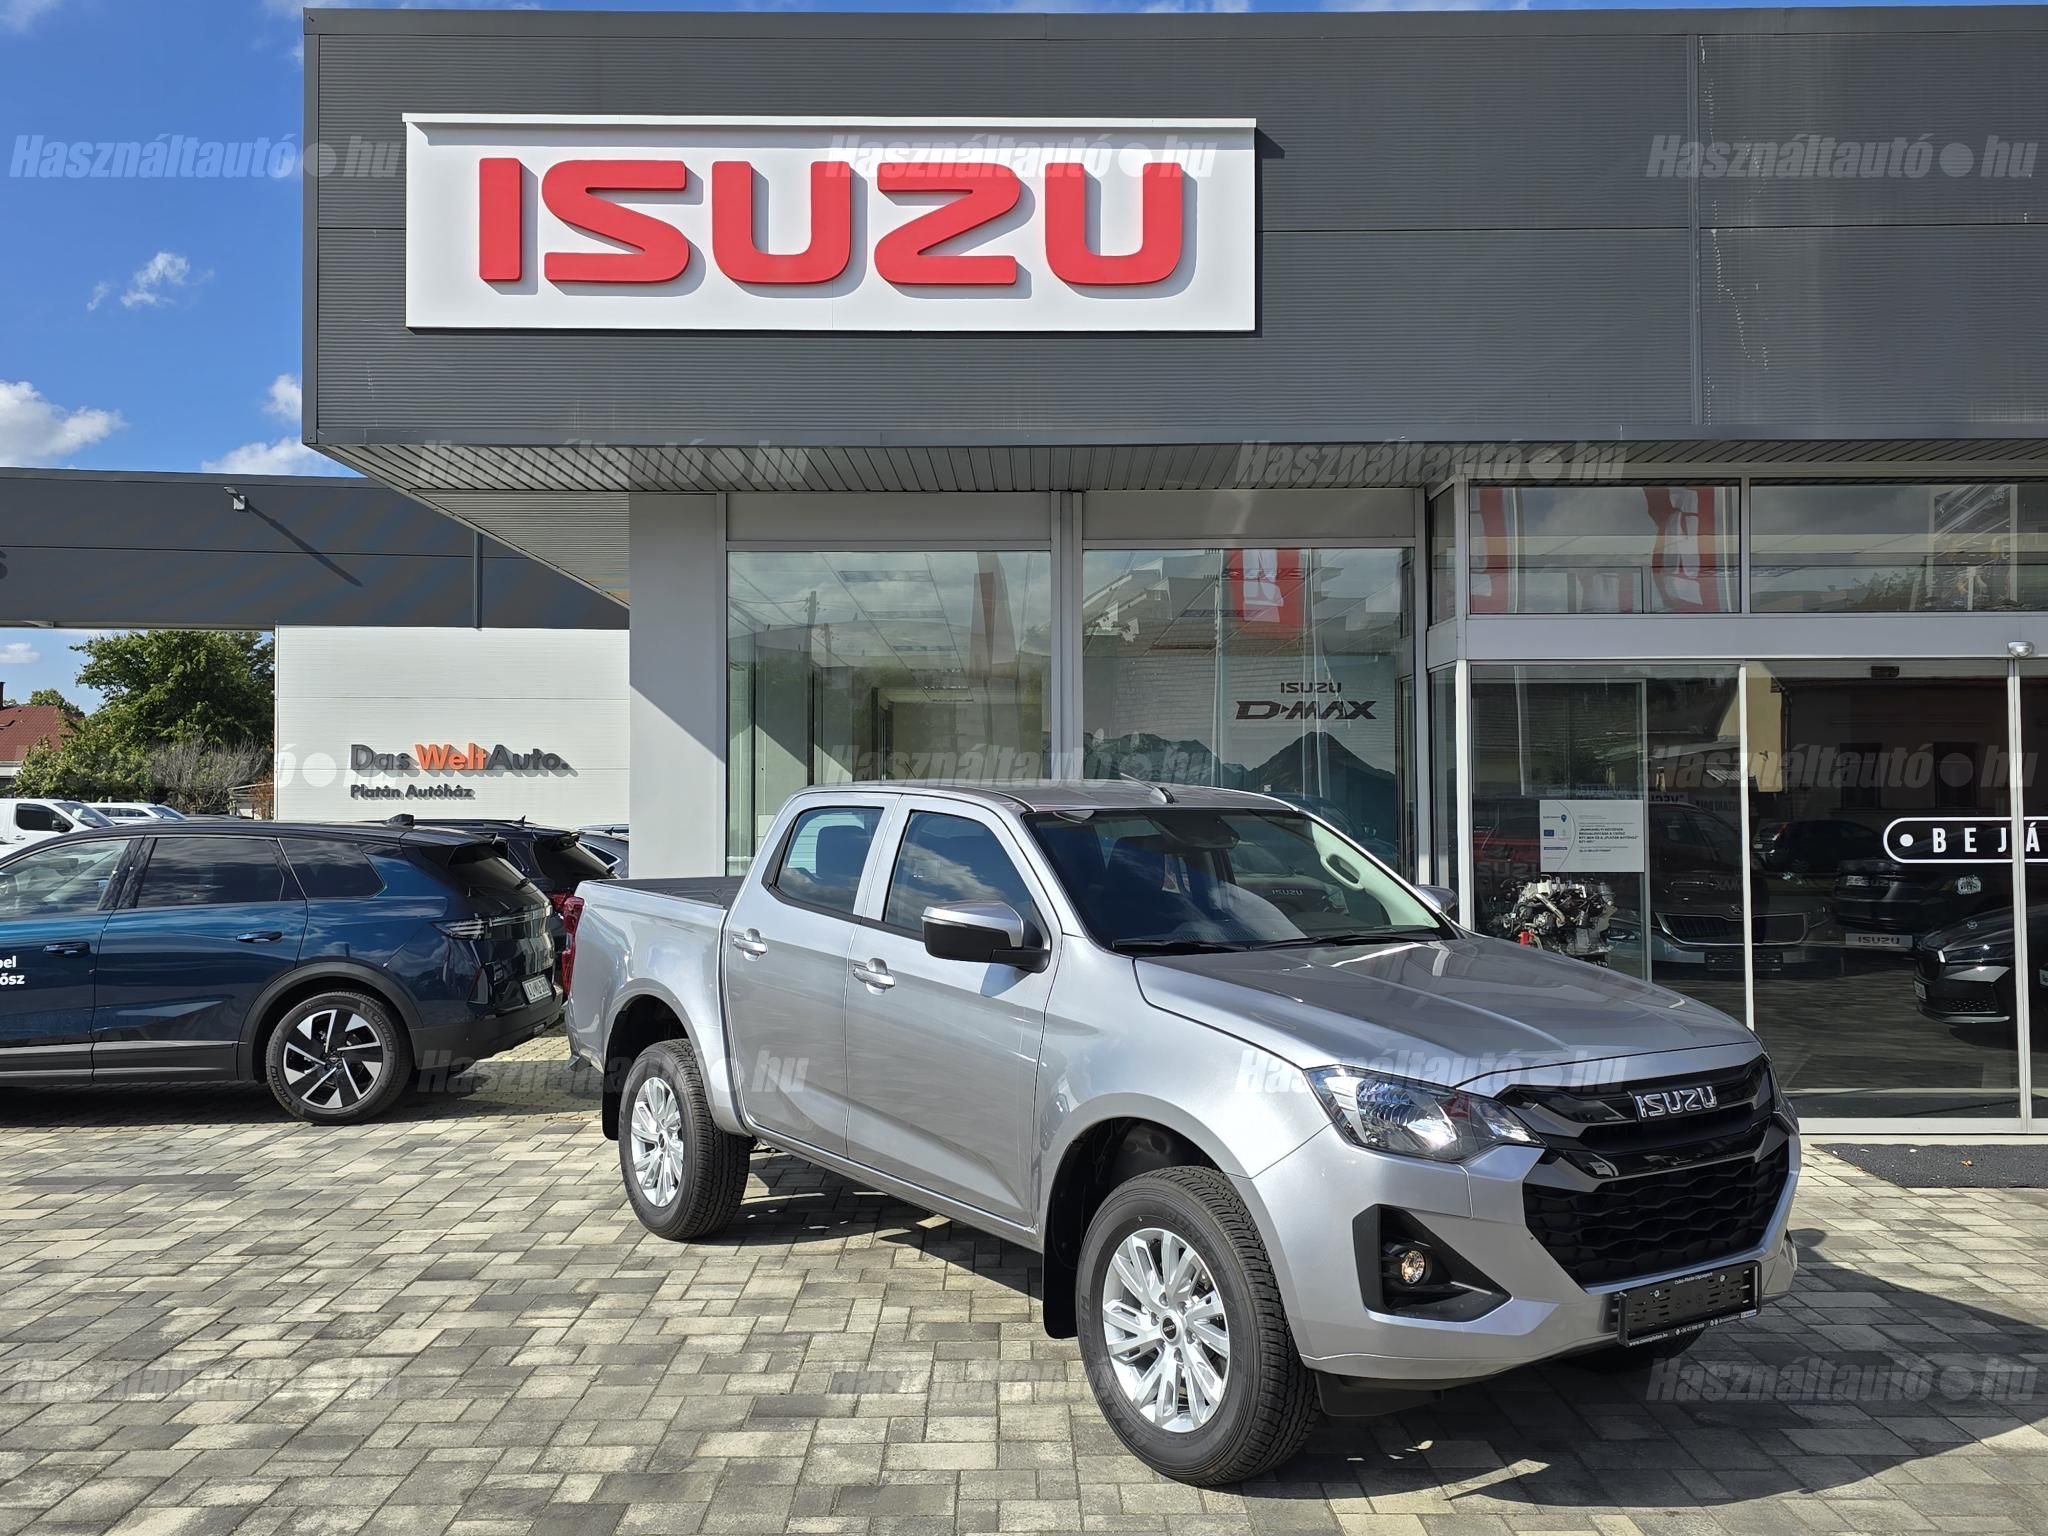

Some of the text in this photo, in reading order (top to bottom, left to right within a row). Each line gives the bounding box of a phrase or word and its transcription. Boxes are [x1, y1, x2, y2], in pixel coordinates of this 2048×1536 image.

[479, 158, 1182, 286] ISUZU
[1280, 682, 1342, 694] ISUZU
[350, 744, 412, 771] Das
[350, 783, 474, 799] Platán Autóház
[1857, 936, 1901, 945] ISUZU
[1635, 1086, 1718, 1118] ISUZU
